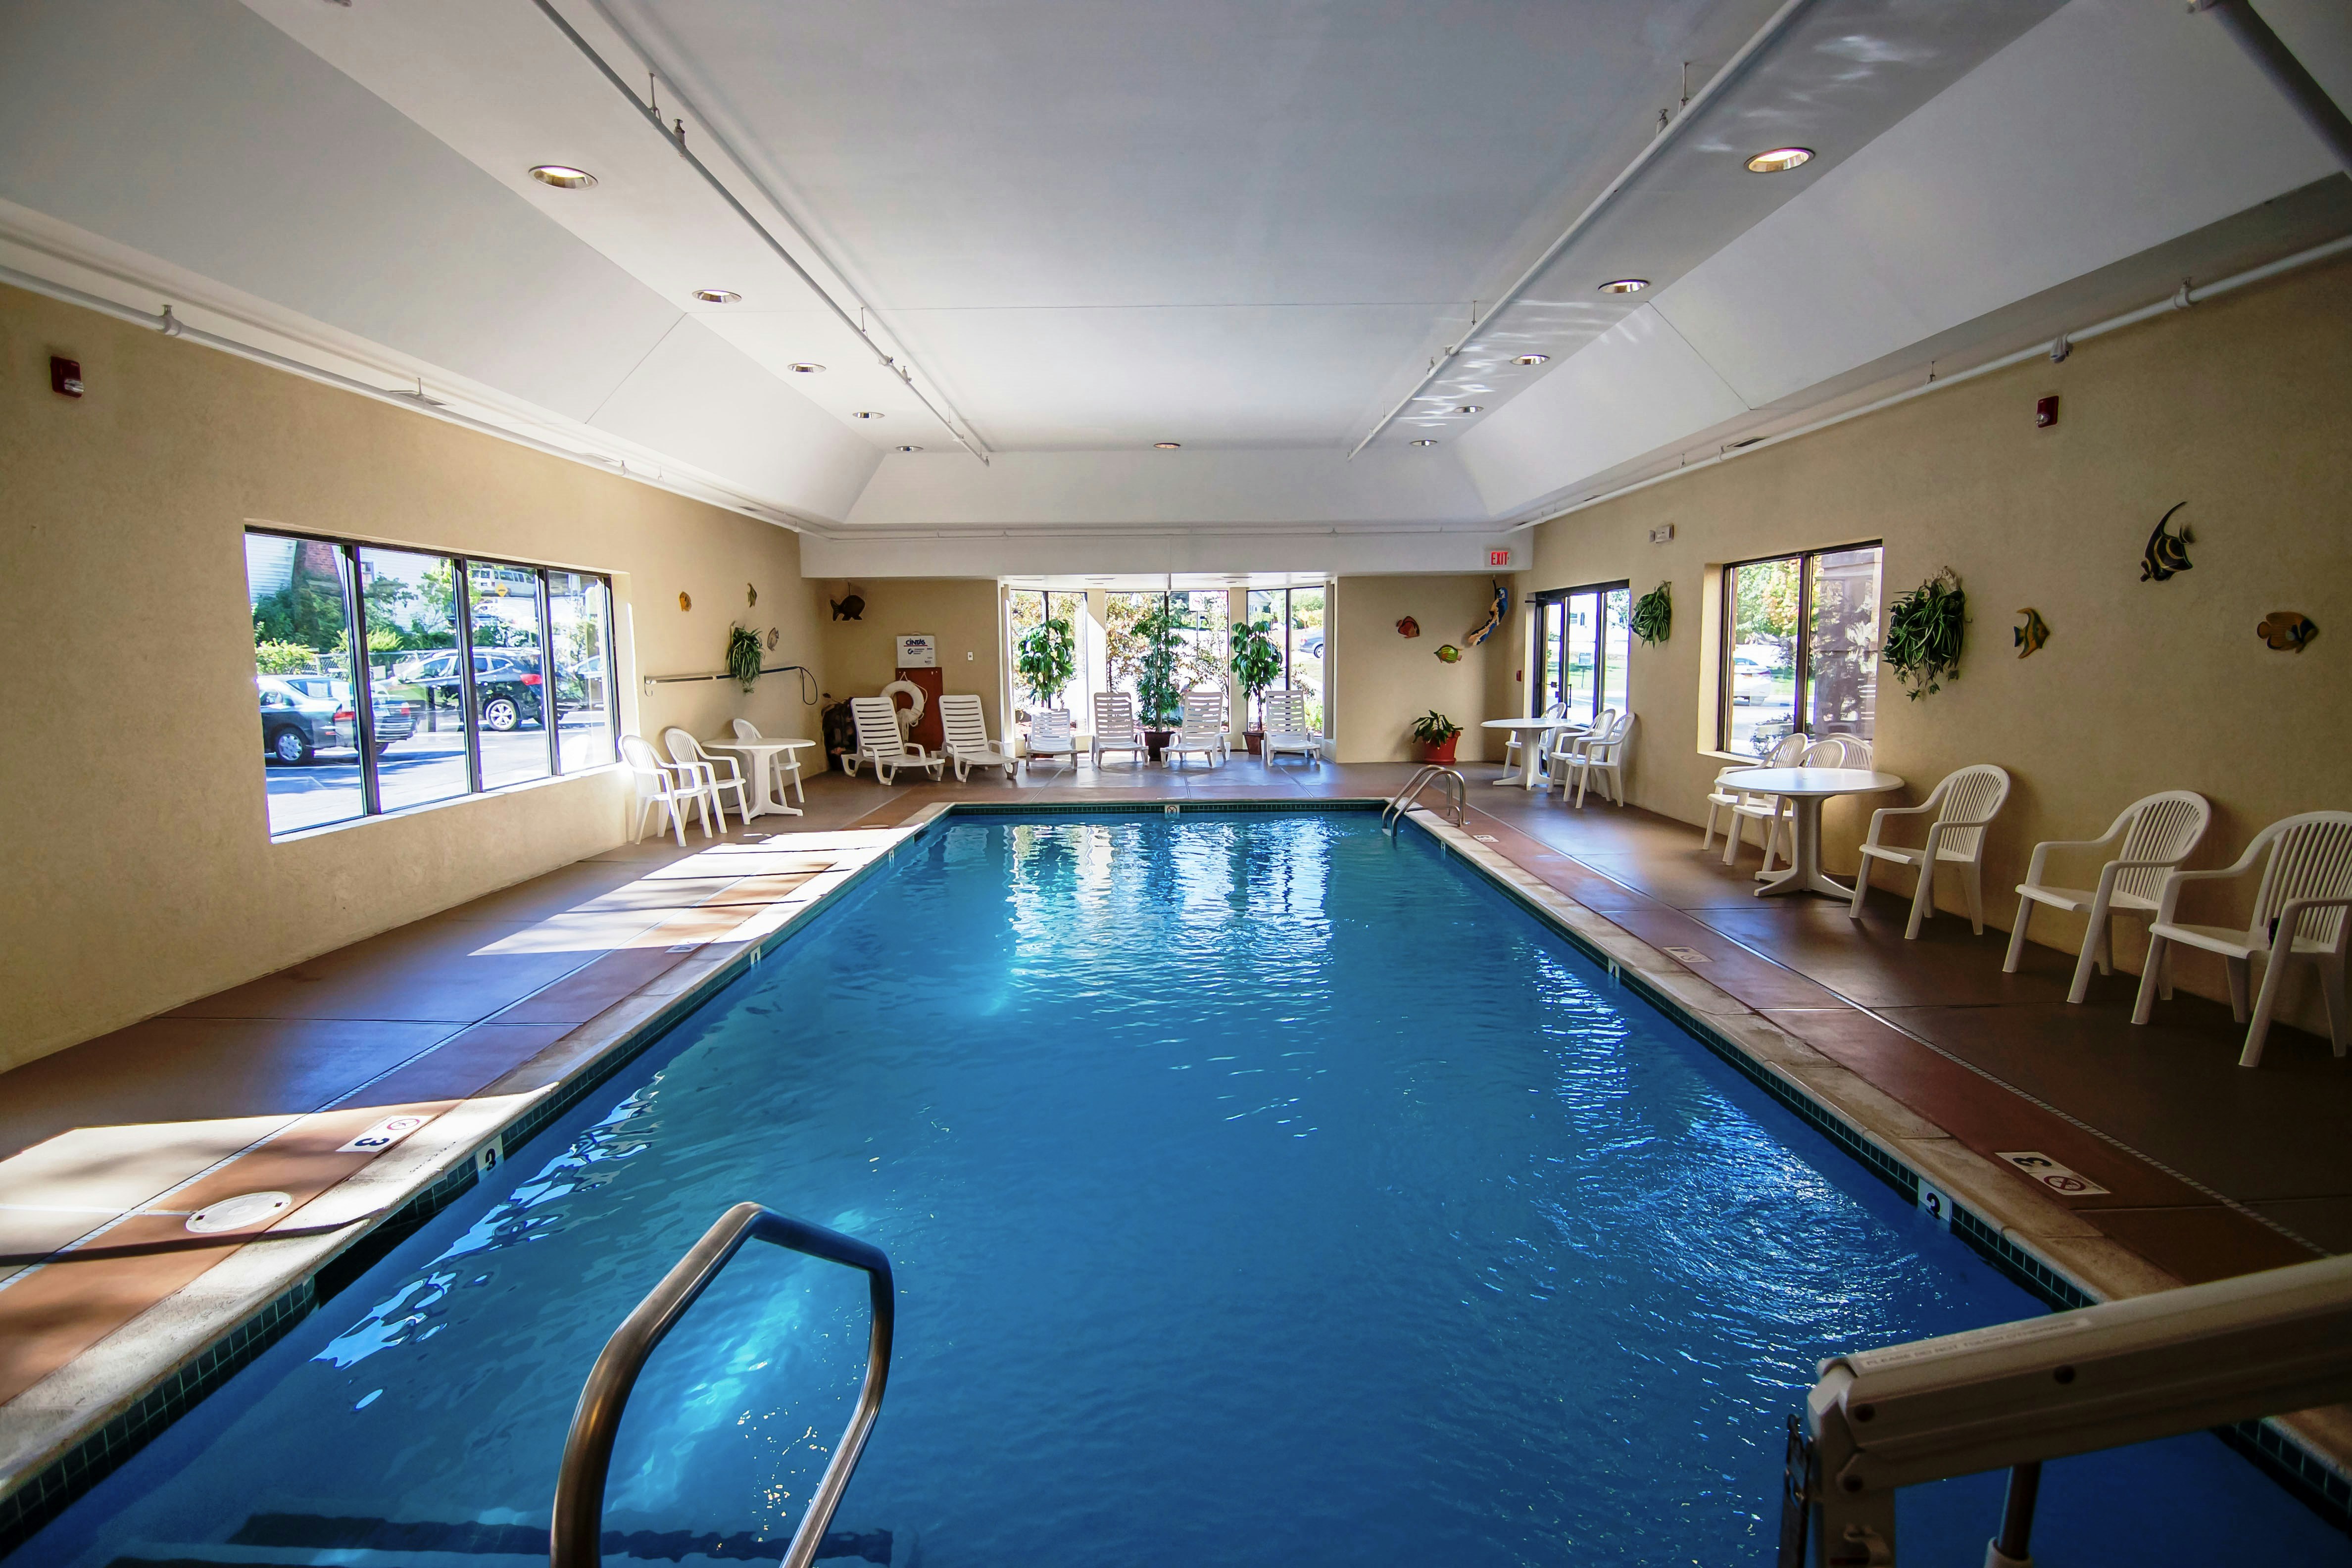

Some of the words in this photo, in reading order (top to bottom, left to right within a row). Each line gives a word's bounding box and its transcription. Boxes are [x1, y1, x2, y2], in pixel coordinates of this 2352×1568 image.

[1491, 552, 1508, 565] EXIT
[354, 1137, 390, 1146] 3
[486, 1148, 496, 1171] 3
[2012, 1157, 2053, 1167] 3
